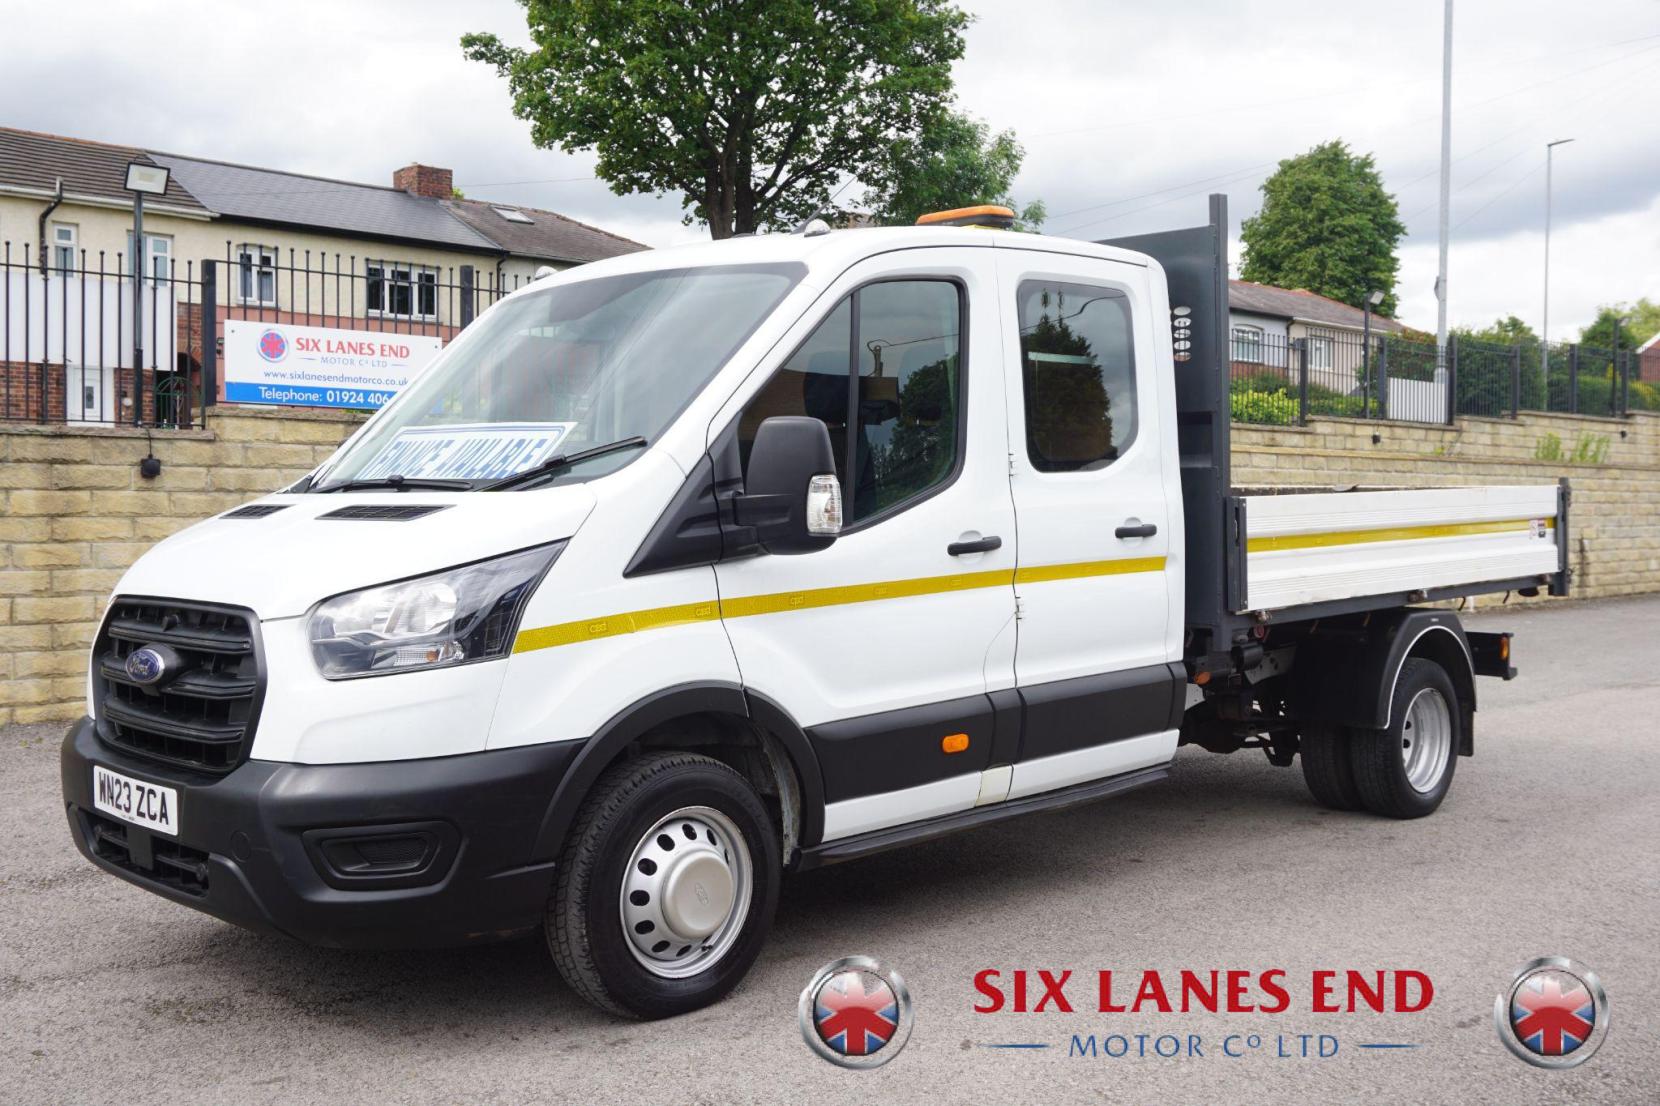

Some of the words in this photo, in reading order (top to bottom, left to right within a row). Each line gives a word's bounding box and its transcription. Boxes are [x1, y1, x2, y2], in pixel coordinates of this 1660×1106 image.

[296, 337, 321, 352] SIX
[326, 340, 376, 356] LANES
[380, 344, 410, 359] END
[320, 356, 355, 367] MOTOR
[371, 360, 388, 368] LTD
[263, 370, 408, 386] www.sixlanesendmotorco.co.uk
[258, 386, 322, 402] Telephone:
[326, 390, 364, 405] 01924
[98, 771, 131, 813] WN23
[135, 784, 169, 826] ZCA
